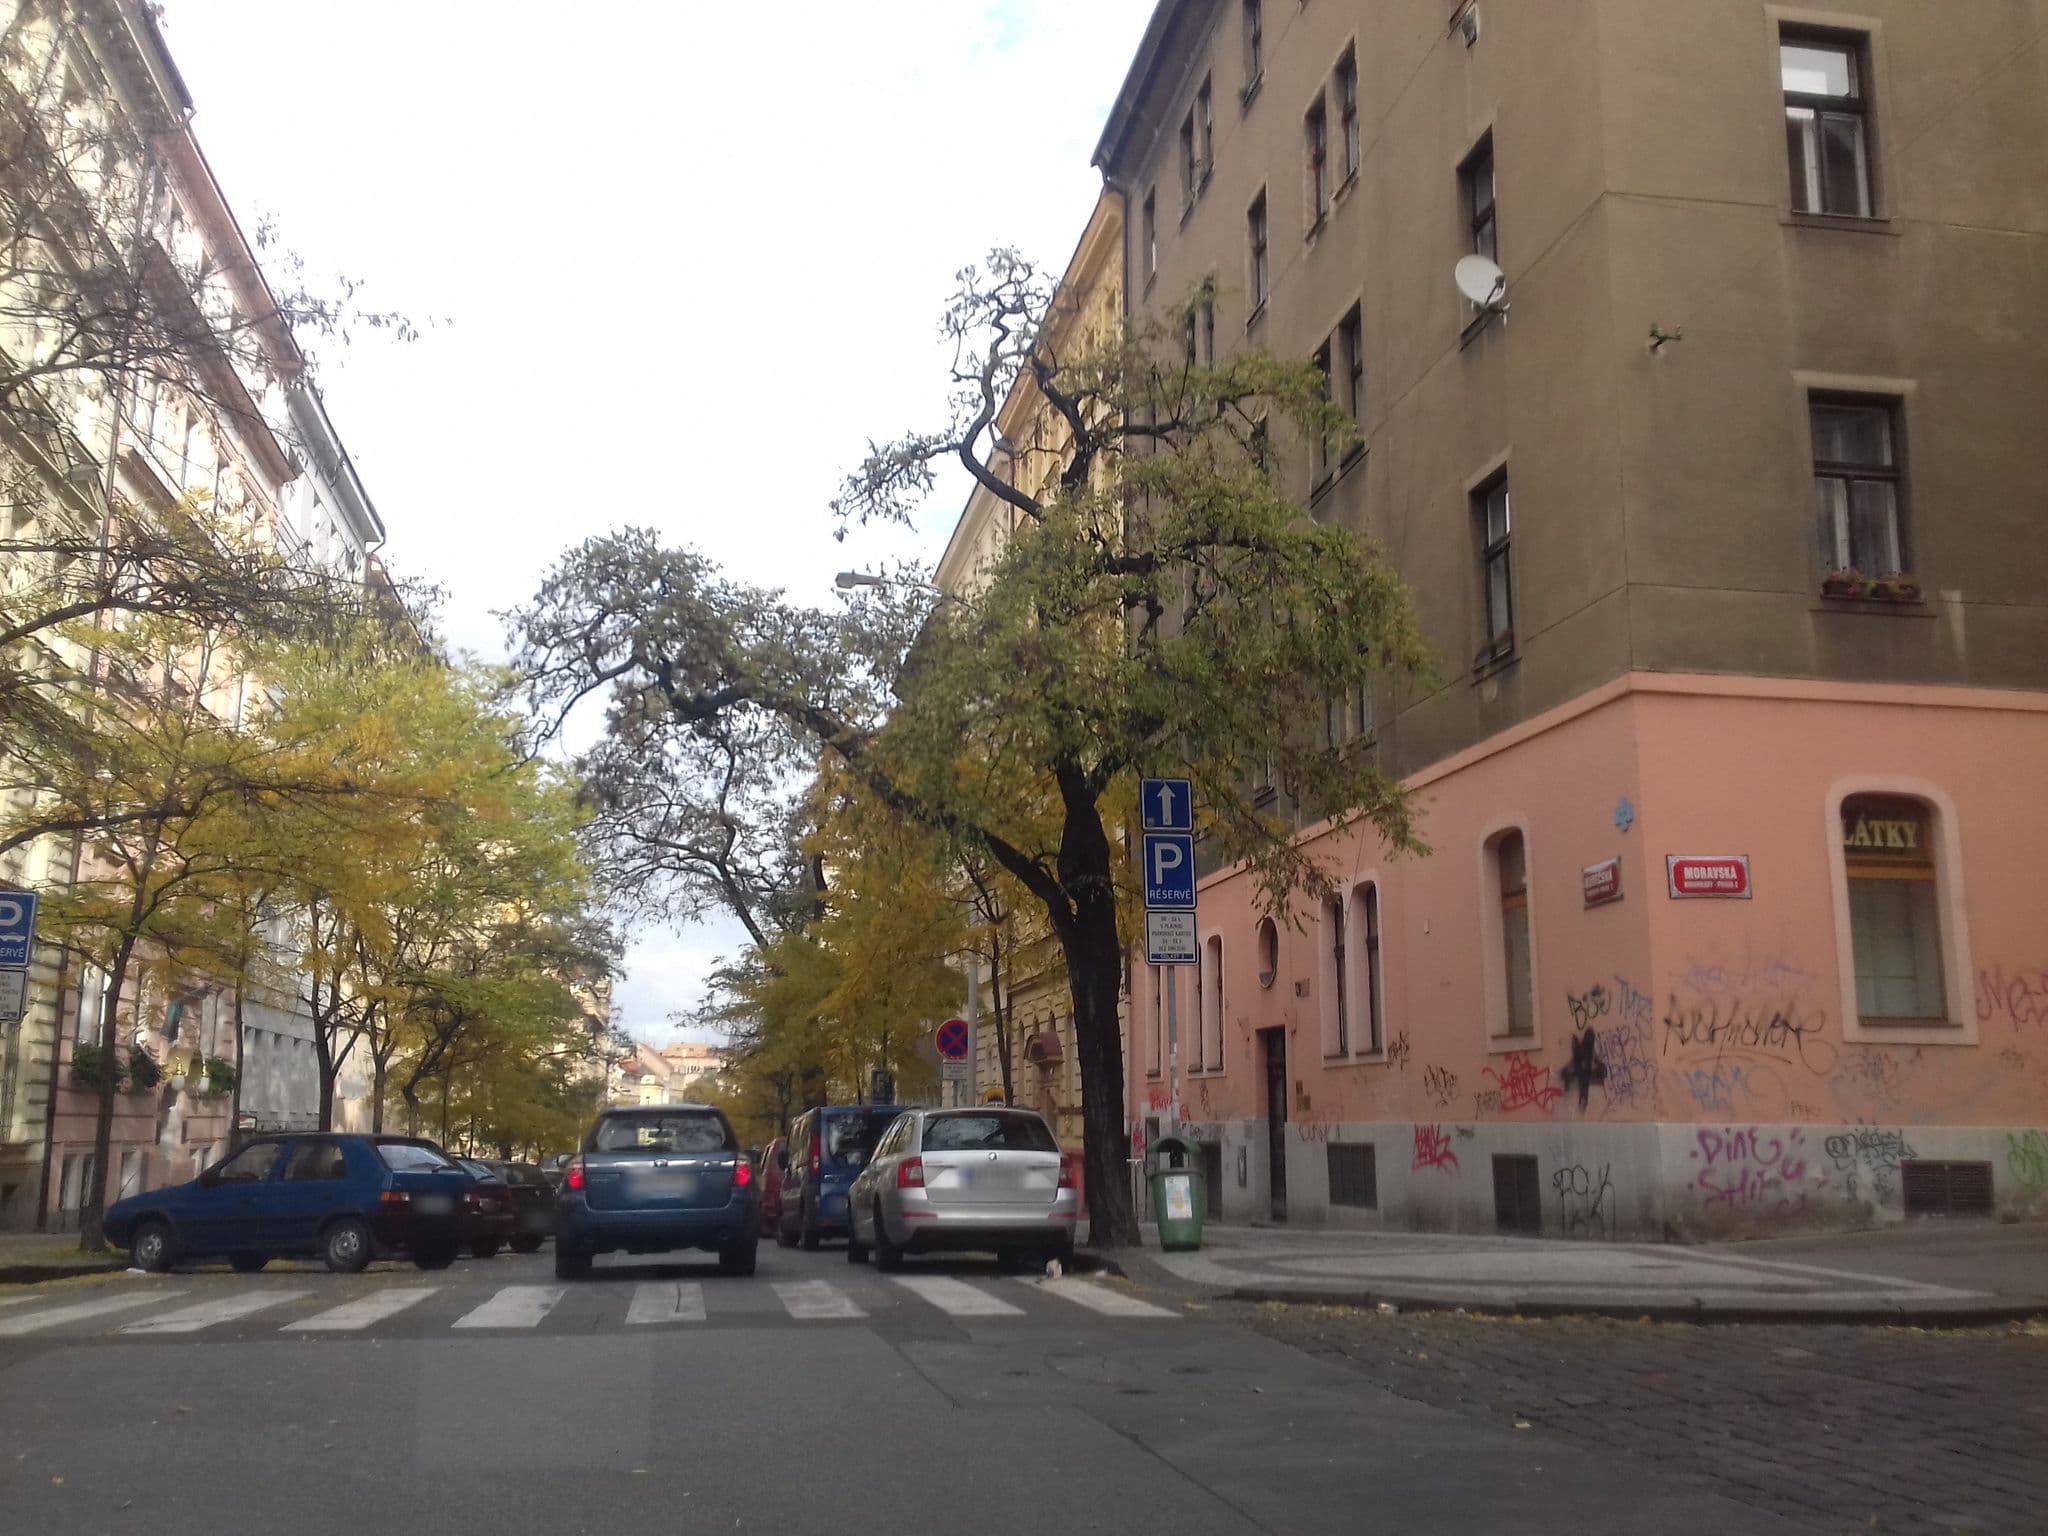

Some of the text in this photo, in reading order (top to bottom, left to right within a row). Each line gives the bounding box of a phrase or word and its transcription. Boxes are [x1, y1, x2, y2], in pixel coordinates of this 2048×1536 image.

[1154, 843, 1183, 885] P
[1684, 866, 1737, 880] MORAVSKÁ
[1149, 888, 1192, 900] RÉSERVÉ
[0, 946, 24, 958] ERVÉ
